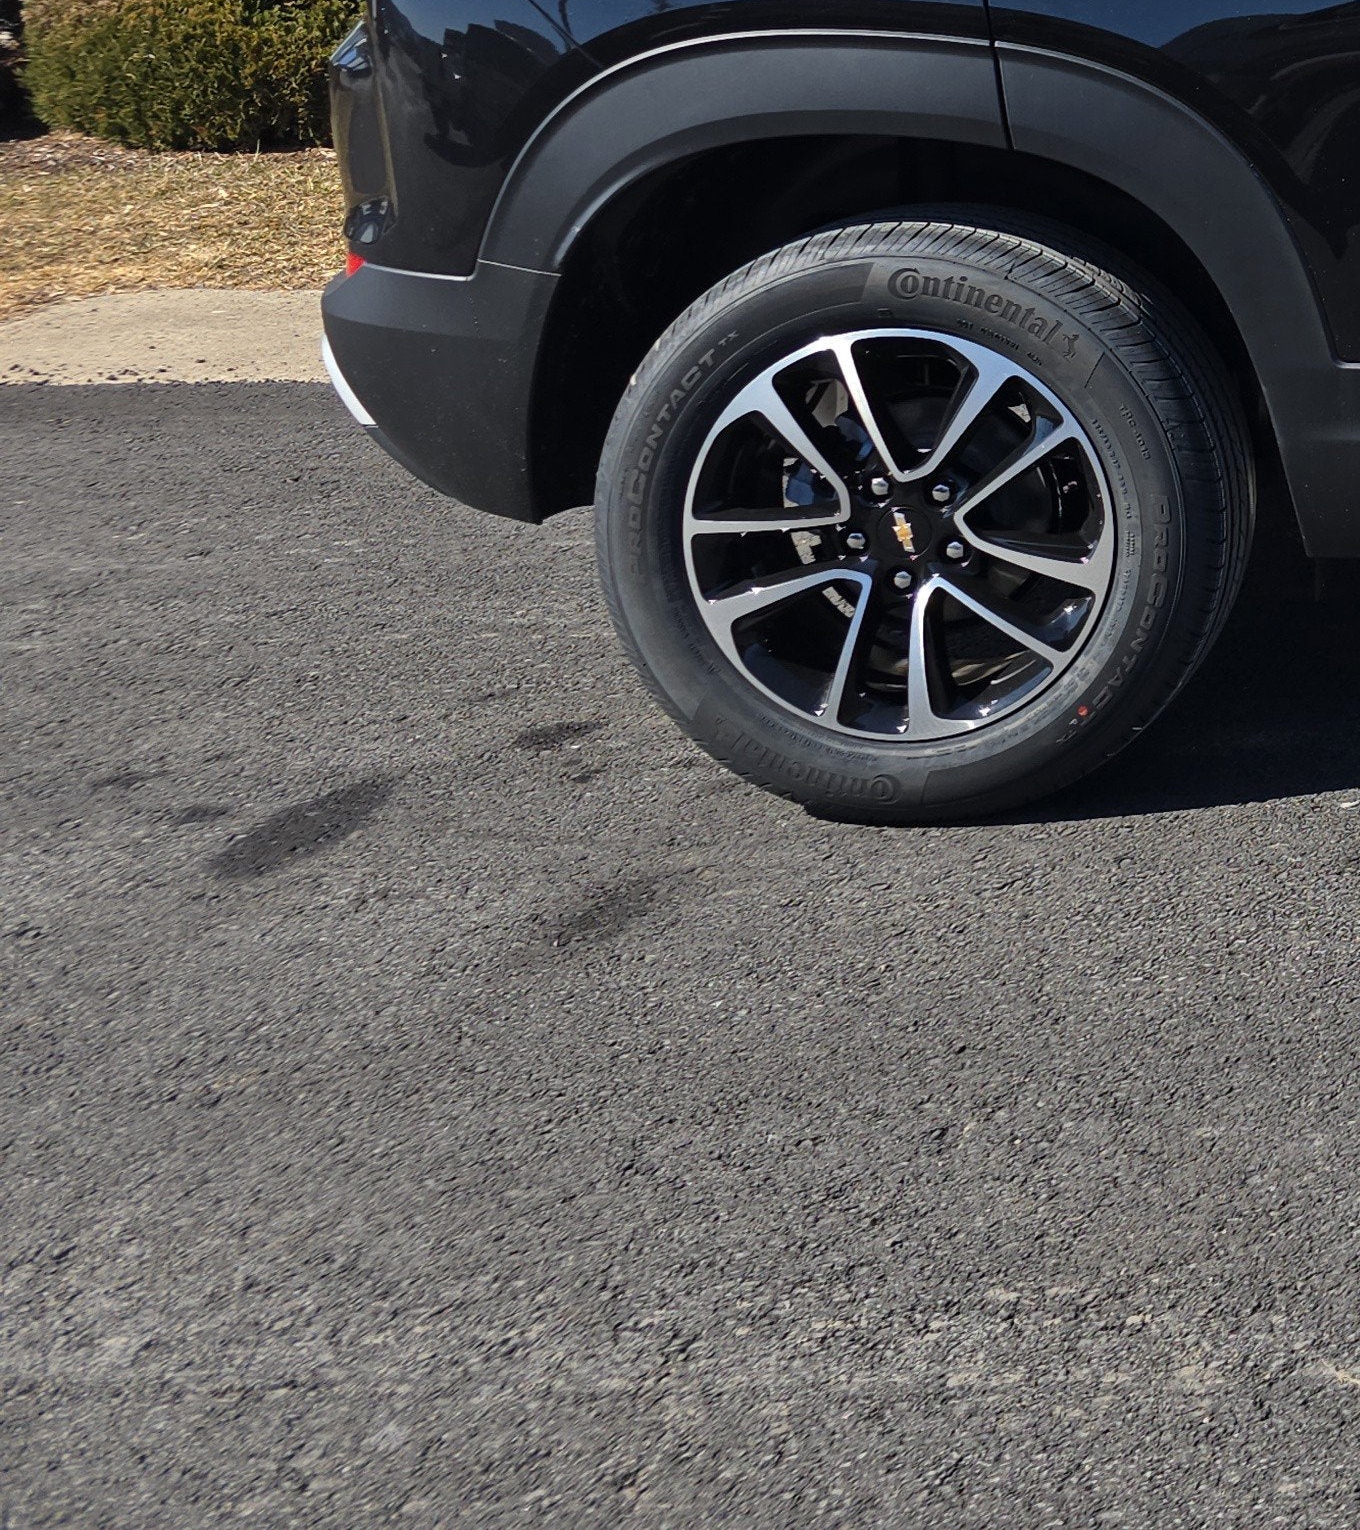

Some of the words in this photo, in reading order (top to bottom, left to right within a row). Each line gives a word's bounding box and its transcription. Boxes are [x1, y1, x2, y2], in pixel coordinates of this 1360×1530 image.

[888, 267, 1064, 347] Continental
[628, 348, 716, 575] PROCONTACT
[729, 732, 903, 806] Continental
